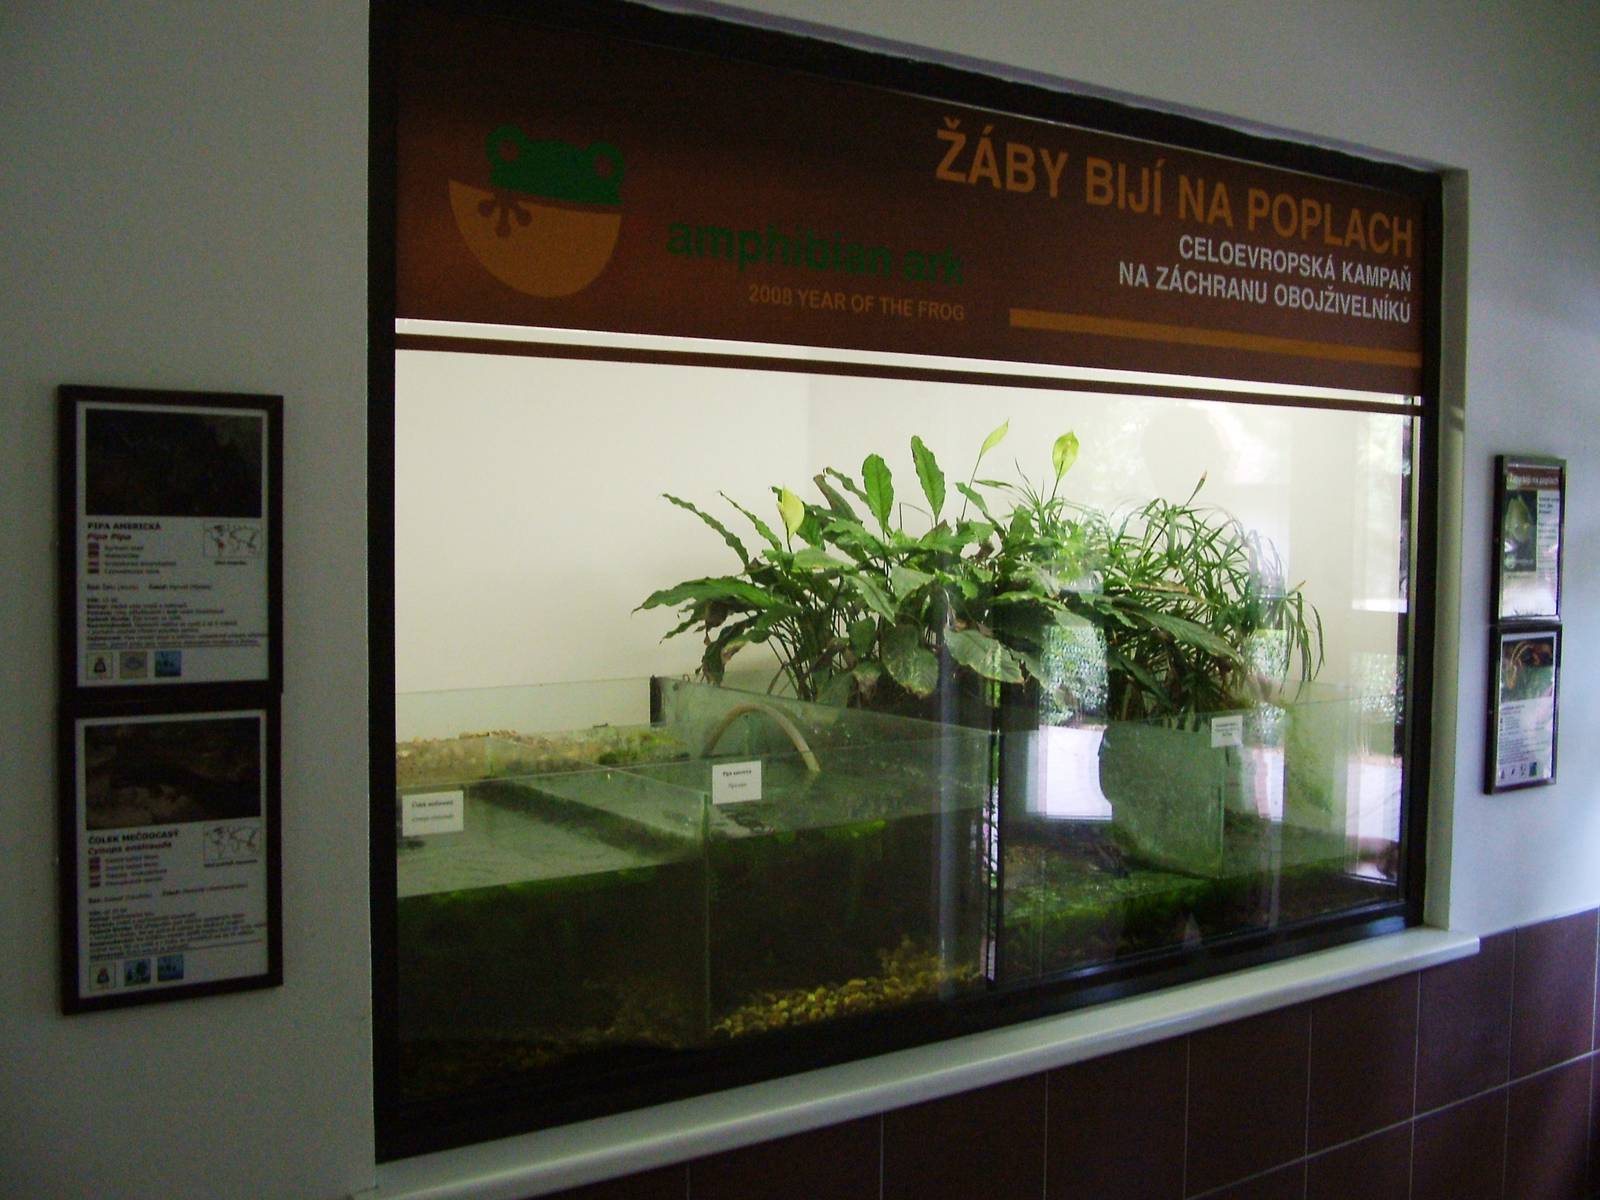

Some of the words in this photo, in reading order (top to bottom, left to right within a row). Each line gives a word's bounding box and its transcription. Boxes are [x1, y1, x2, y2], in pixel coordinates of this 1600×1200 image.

[935, 116, 1069, 199] ŽÁBY
[1086, 157, 1166, 216] BIJÍ
[1178, 174, 1233, 228] NA
[1248, 187, 1412, 258] POPLACH
[666, 222, 892, 278] amphibian
[903, 245, 963, 287] ark
[1118, 261, 1149, 289] NA
[1156, 264, 1267, 305] ZÁCHRANU
[1179, 234, 1336, 281] CELOEVROPSKÁ
[1342, 260, 1412, 292] KAMPAŇ
[748, 283, 793, 306] 2008
[797, 288, 847, 312] YEAR
[850, 293, 876, 314] OF
[879, 296, 914, 318] THE
[917, 299, 966, 322] FROG
